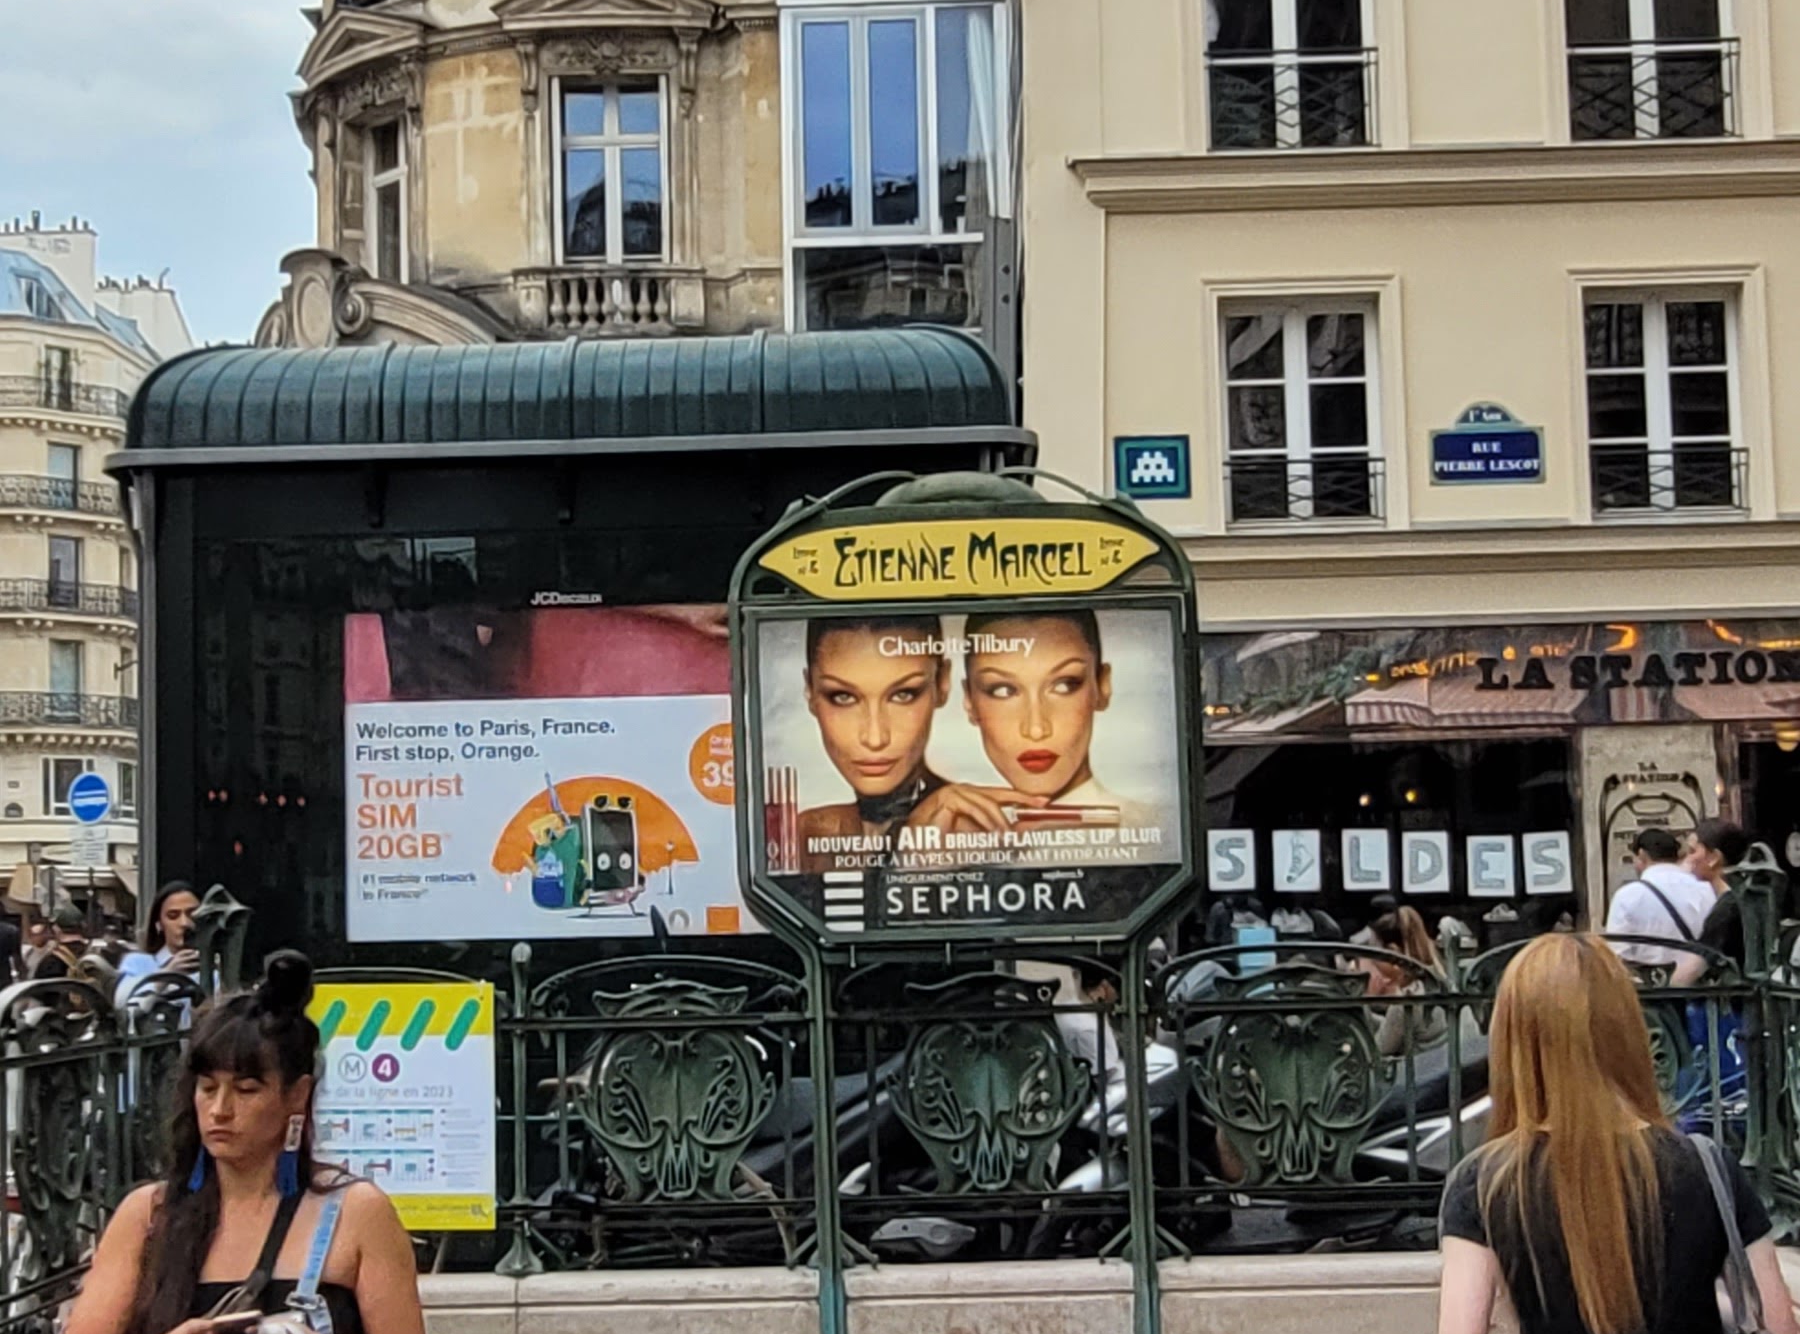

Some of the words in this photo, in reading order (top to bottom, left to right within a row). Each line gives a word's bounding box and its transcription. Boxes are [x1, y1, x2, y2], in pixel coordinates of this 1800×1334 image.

[1471, 442, 1502, 454] RUE
[1434, 460, 1486, 472] PIERRE
[1489, 458, 1540, 471] LESCOT
[968, 531, 1093, 587] MARCEL
[1474, 656, 1555, 691] LA
[1568, 649, 1800, 689] STATION
[356, 721, 449, 739] Welcome
[454, 721, 475, 738] to
[480, 718, 536, 739] Paris,
[542, 717, 616, 735] France.
[355, 744, 401, 762] First
[405, 744, 455, 764] stop,
[356, 771, 465, 799] Tourist
[356, 802, 417, 830] SIM
[807, 835, 892, 854] NOUVEAU!
[898, 825, 942, 851] AIR
[945, 830, 999, 850] BRUSH
[1003, 828, 1086, 849] FLAWLESS
[1089, 827, 1115, 845] LIP
[1119, 825, 1162, 845] BLUR
[956, 849, 1016, 866] LIQUIDE
[1017, 847, 1051, 863] MAT
[886, 880, 1087, 915] SEPHORA
[377, 1058, 393, 1078] 4
[354, 1086, 366, 1098] la
[369, 1085, 399, 1101] ligne
[403, 1088, 419, 1098] en
